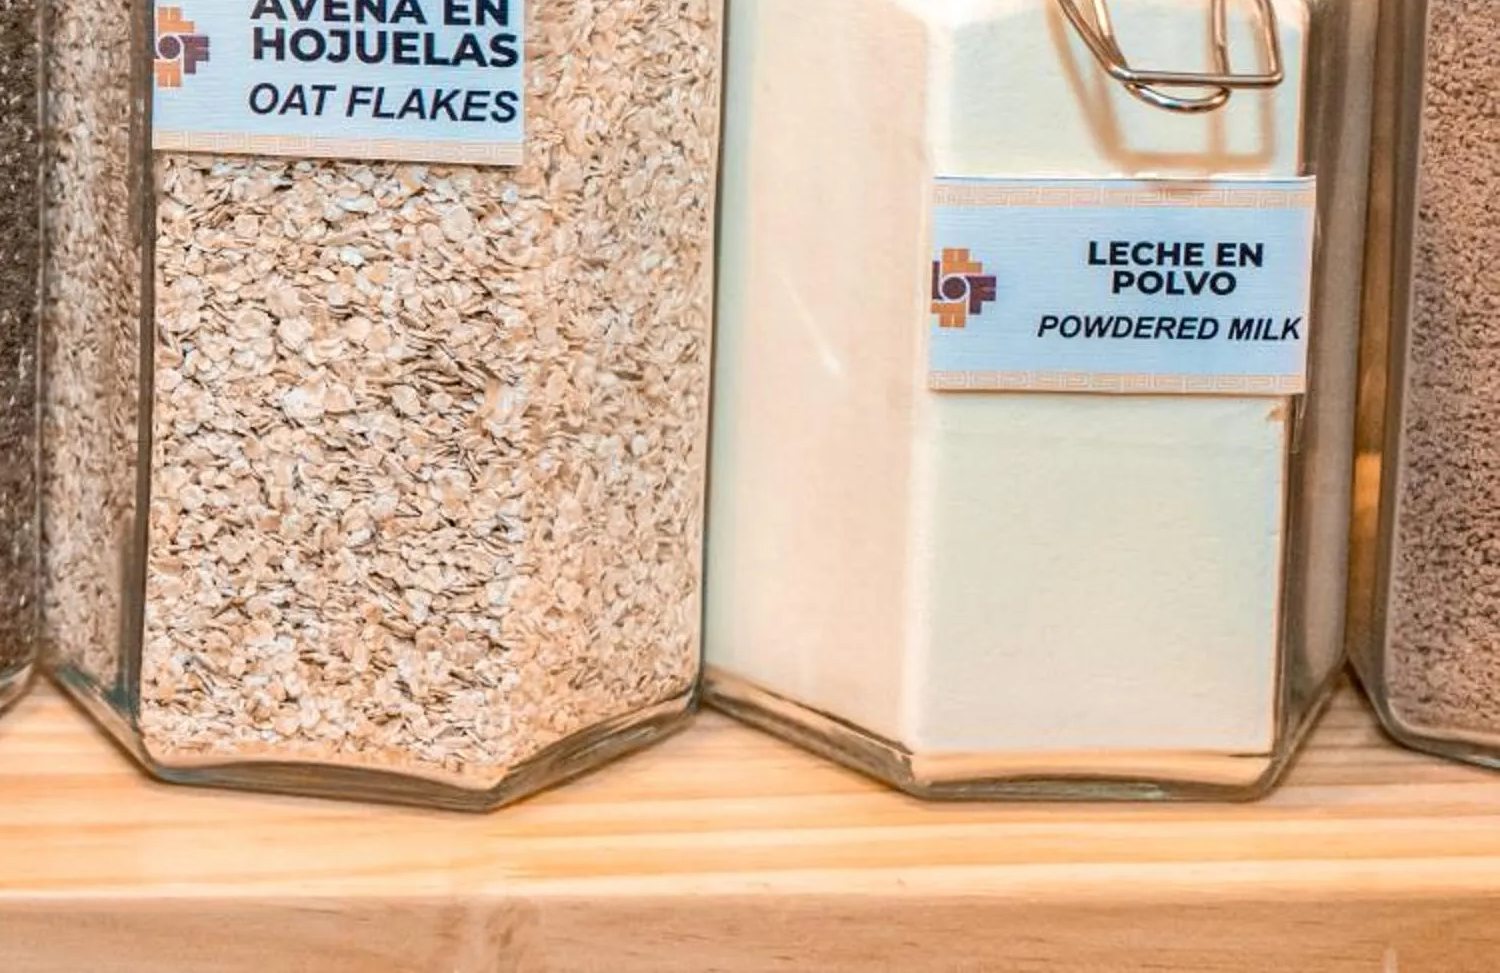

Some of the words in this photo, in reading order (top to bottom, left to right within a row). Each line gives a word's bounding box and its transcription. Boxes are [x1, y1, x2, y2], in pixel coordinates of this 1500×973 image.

[252, 27, 520, 68] HOJUELAS
[248, 82, 337, 116] OAT
[345, 85, 520, 123] FLAKES
[1087, 240, 1205, 267] LECHE
[1215, 242, 1265, 268] EN
[1111, 270, 1238, 296] POLVO
[1036, 315, 1219, 340] POWDERED
[1227, 316, 1303, 341] MILK
